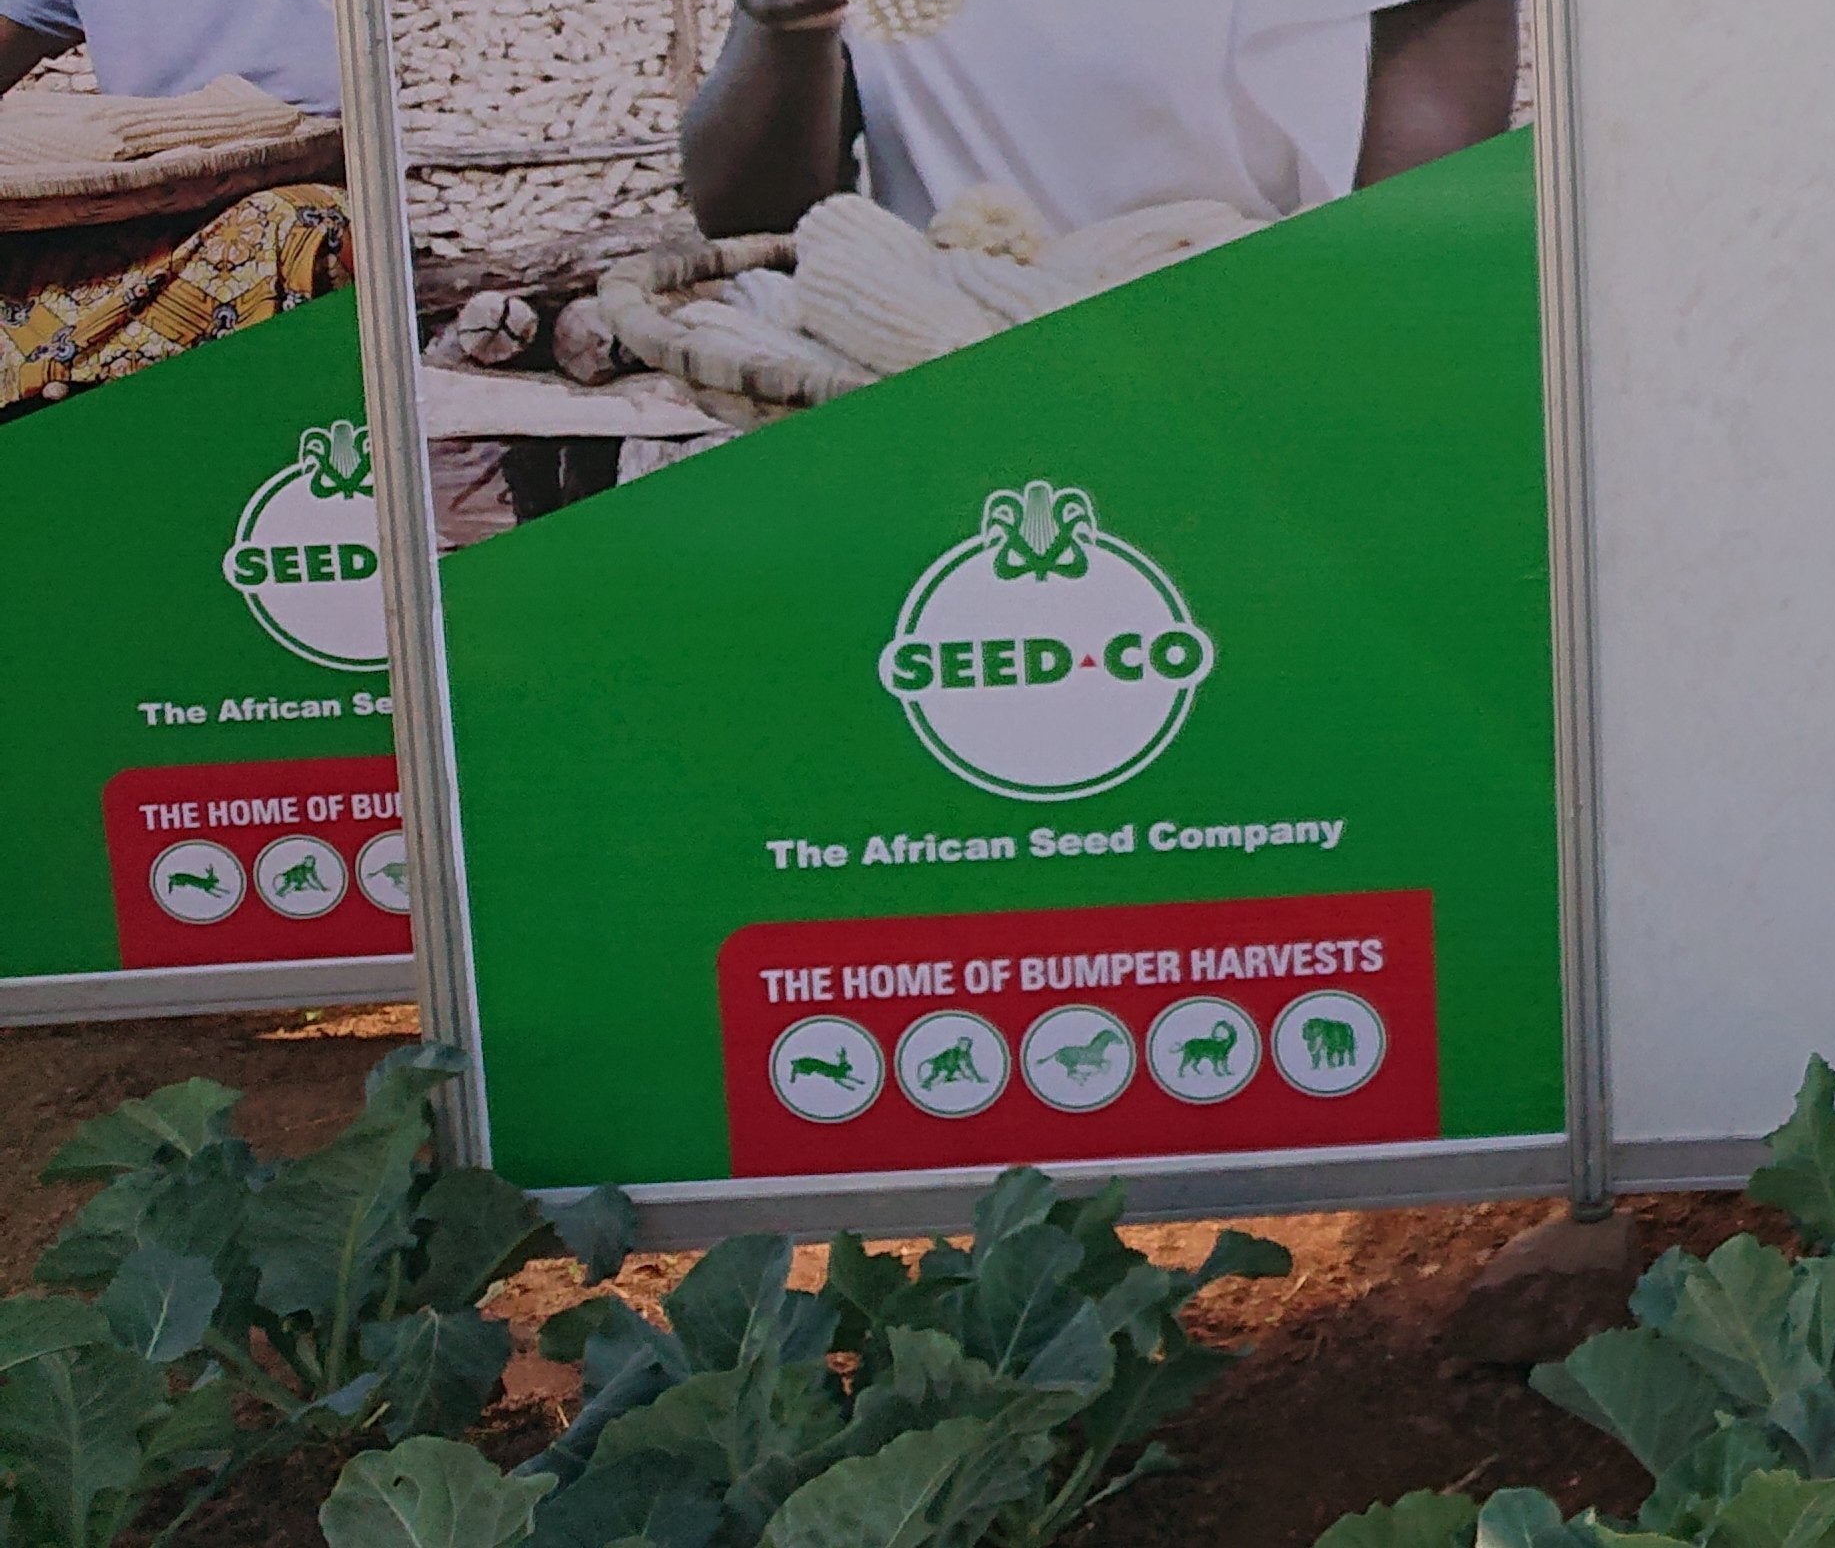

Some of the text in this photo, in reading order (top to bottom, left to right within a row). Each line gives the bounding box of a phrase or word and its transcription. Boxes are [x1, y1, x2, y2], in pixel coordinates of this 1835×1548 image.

[235, 544, 377, 586] SEED
[137, 692, 393, 727] The African Se
[138, 801, 201, 831] THE
[207, 796, 300, 828] HOME
[306, 793, 345, 823] OF
[765, 819, 1345, 870] The African Seed Company
[759, 938, 1384, 1004] THE HOME OF BUMPER HARVESTS
